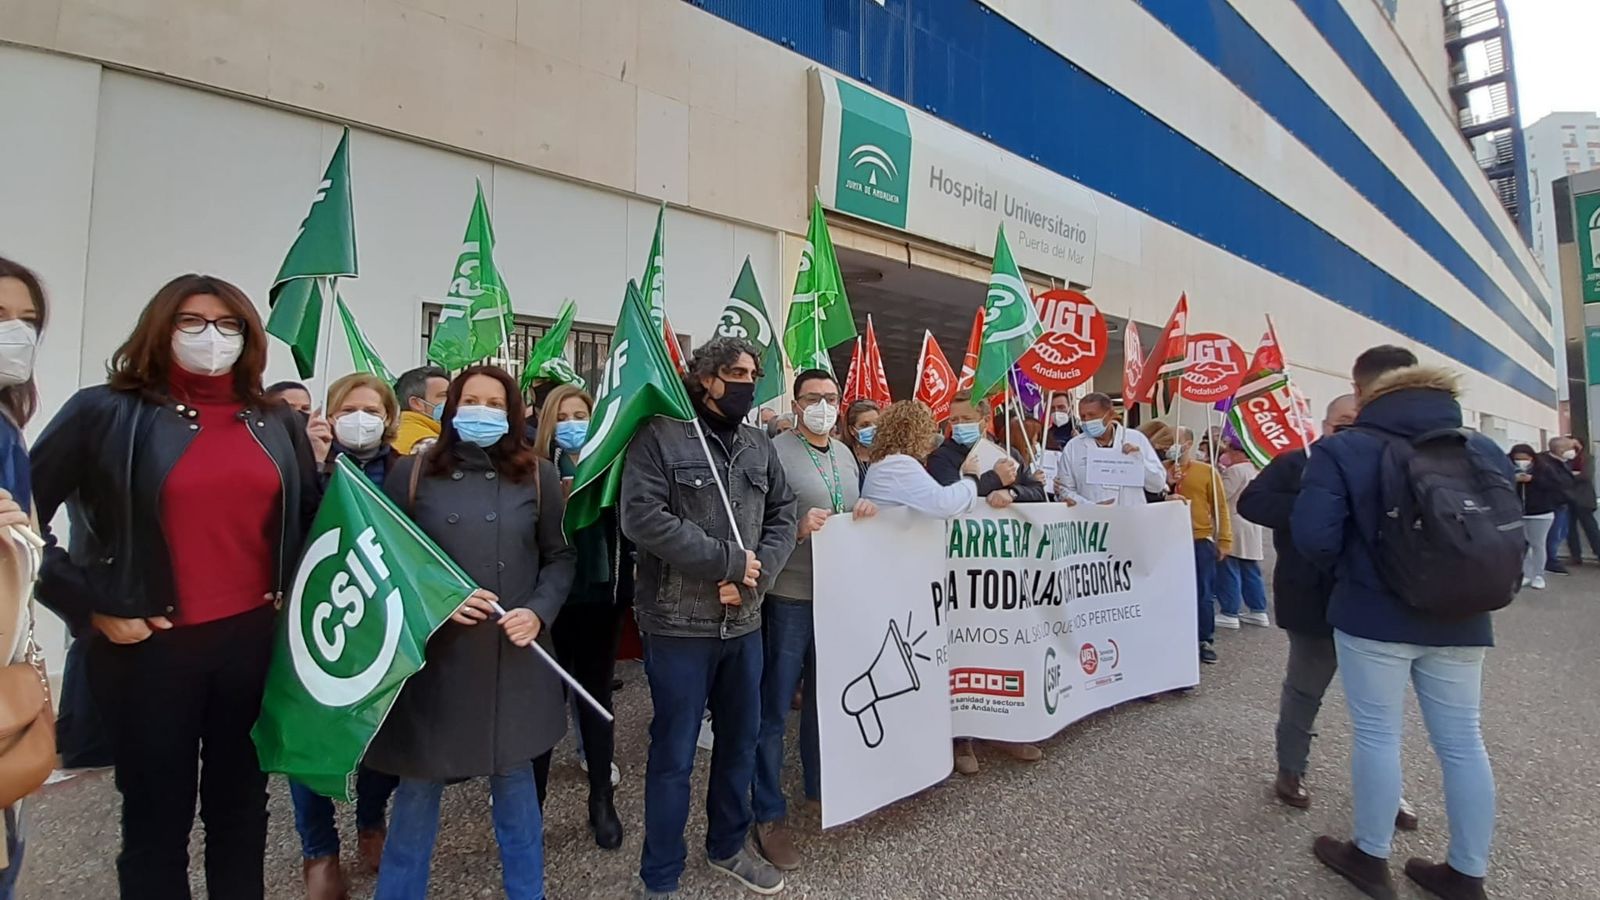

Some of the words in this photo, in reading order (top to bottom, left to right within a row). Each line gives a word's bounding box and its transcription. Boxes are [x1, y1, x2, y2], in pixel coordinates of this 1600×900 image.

[845, 178, 863, 191] JUNTA
[864, 185, 871, 196] DE
[929, 165, 998, 211] Hospital
[1003, 194, 1087, 244] Universitario
[1018, 230, 1050, 254] Puerta
[1052, 242, 1066, 259] del
[1067, 247, 1085, 264] Mar
[1035, 297, 1097, 341] UGT
[1032, 361, 1081, 379] Andalucía
[1247, 396, 1291, 450] Cádiz
[945, 518, 1032, 559] ARRERA
[312, 525, 391, 662] CSIF
[1032, 569, 1063, 606] LAS
[1088, 604, 1141, 625] PERTENECE
[971, 704, 1009, 714] Andalucía
[992, 699, 1025, 707] sectores
